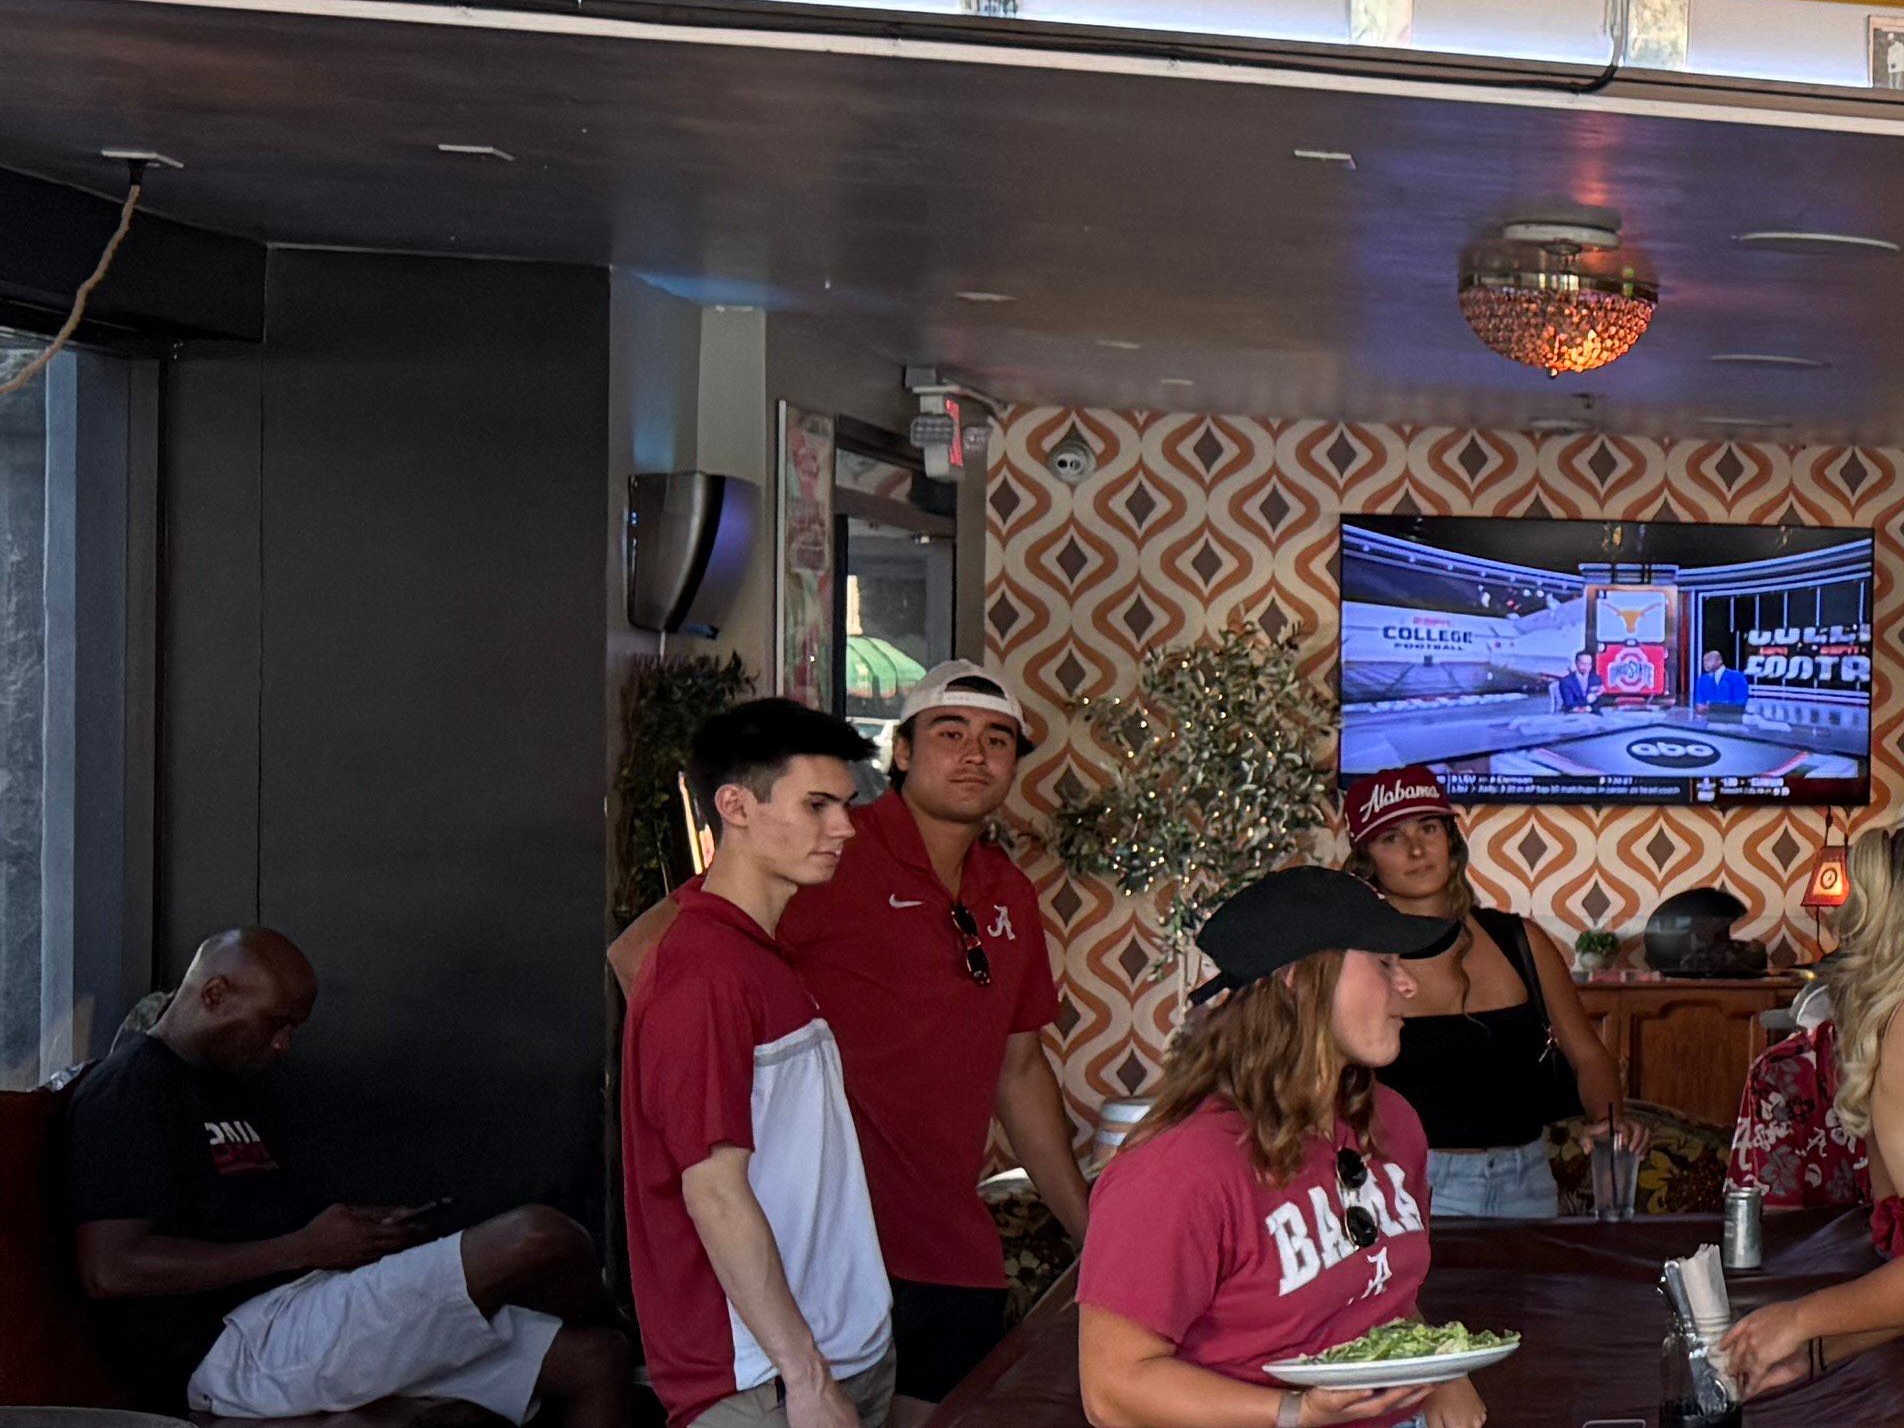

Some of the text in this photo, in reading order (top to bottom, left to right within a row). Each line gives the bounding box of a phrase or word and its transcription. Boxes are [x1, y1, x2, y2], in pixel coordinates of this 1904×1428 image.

[1382, 625, 1473, 645] COLLEGE
[1632, 738, 1713, 760] abc
[1360, 780, 1441, 823] Alabama
[1265, 1163, 1425, 1298] BAMA
